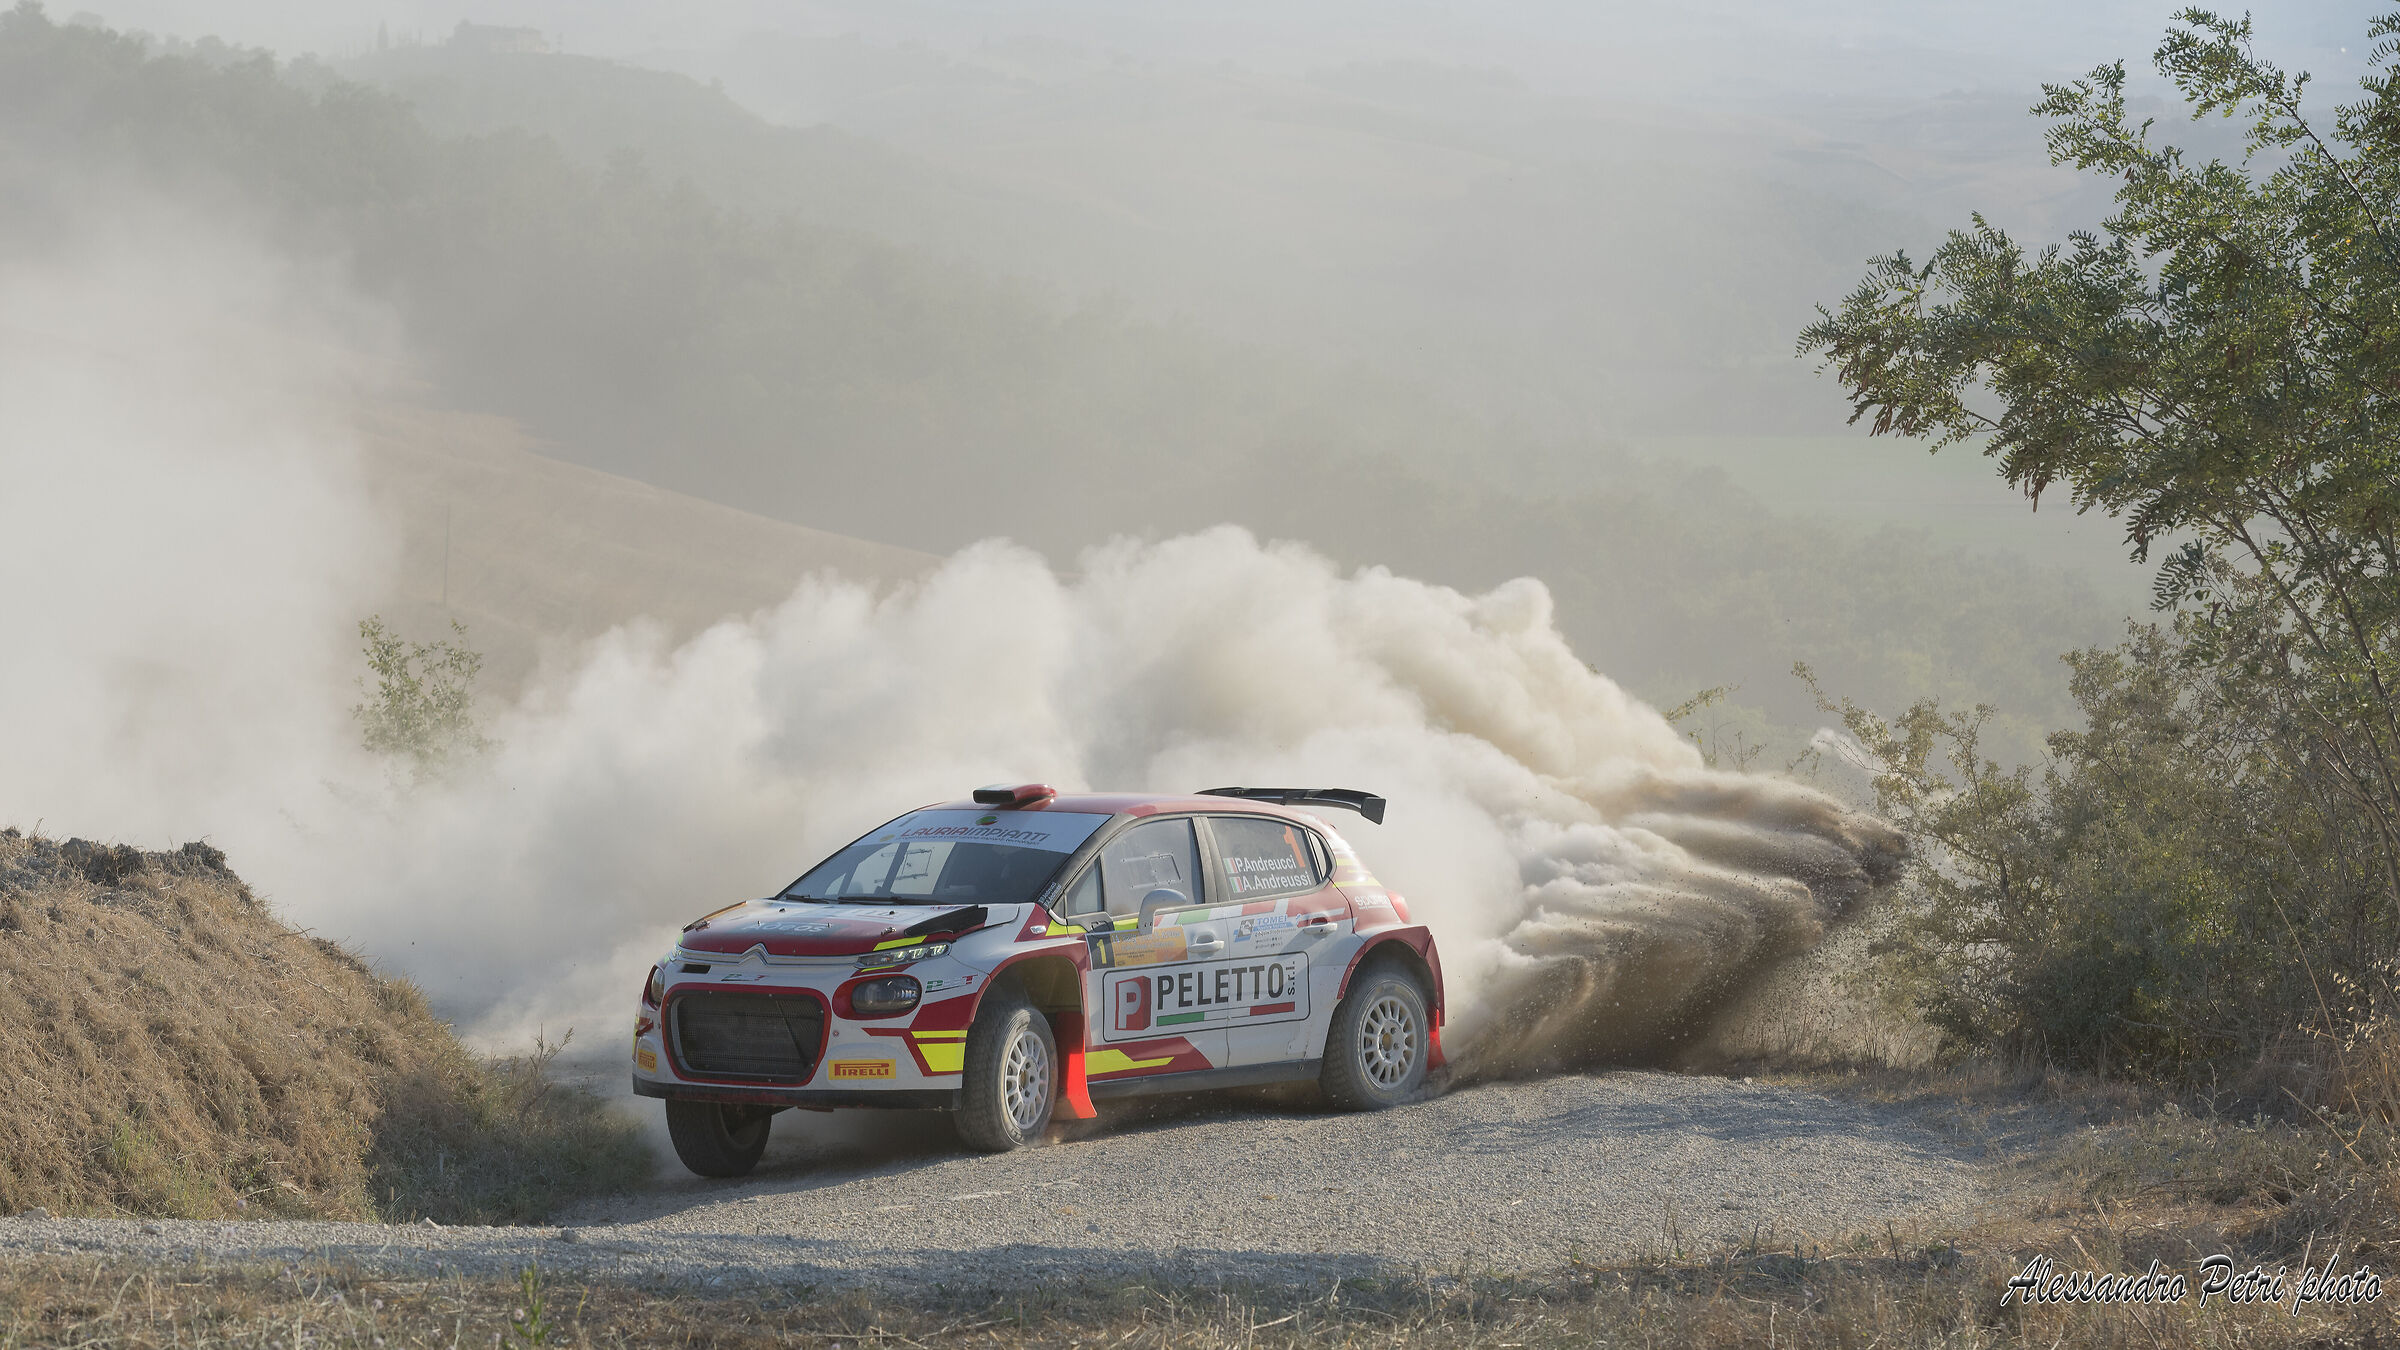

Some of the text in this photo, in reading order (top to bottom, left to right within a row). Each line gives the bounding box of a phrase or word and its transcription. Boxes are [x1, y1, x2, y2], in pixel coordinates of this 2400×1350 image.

[1283, 825, 1306, 868] 1
[1234, 854, 1297, 872] P.Andreucci
[1256, 915, 1287, 925] TOMEI
[1096, 938, 1107, 964] 1
[1157, 963, 1284, 1010] PELETTO
[1118, 980, 1142, 1029] P
[834, 1063, 890, 1076] PIRELLI
